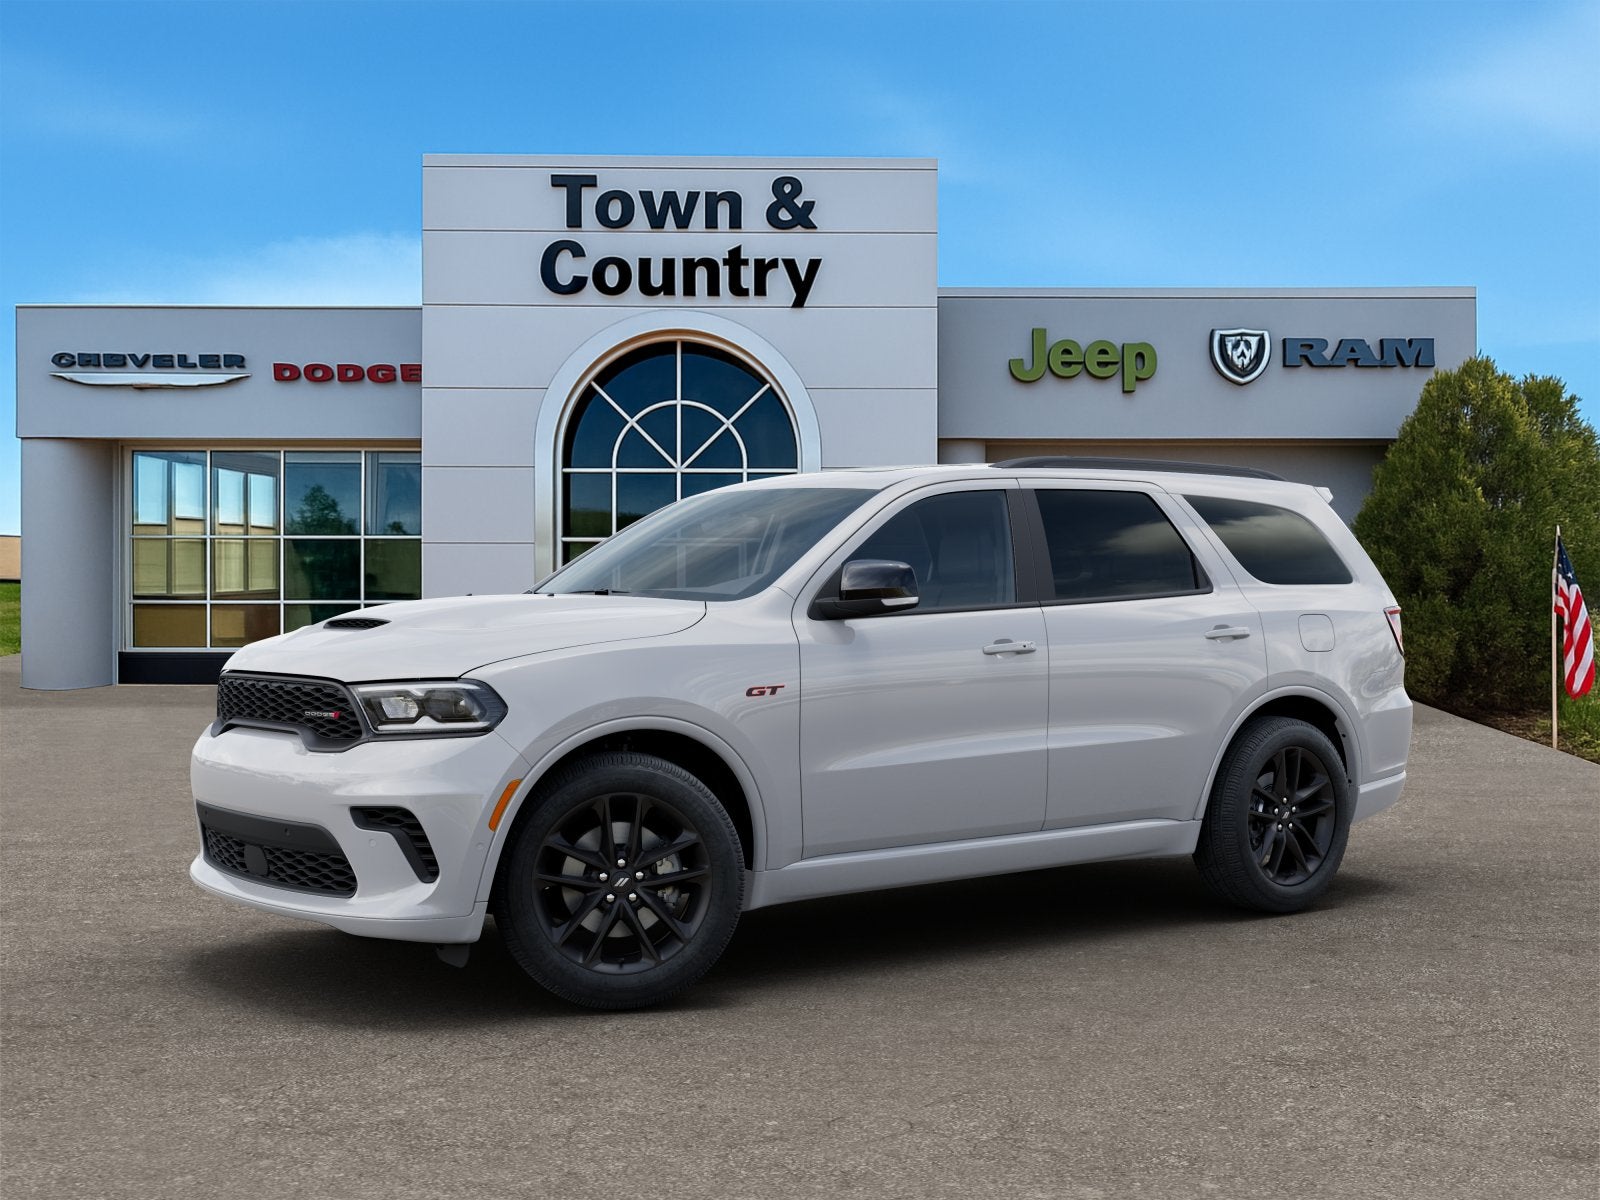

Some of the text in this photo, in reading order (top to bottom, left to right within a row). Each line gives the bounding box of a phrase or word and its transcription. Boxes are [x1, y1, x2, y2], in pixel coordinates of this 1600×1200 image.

[550, 174, 818, 229] Town &
[540, 239, 822, 308] Country
[272, 363, 422, 383] DODGE
[1009, 327, 1158, 393] Jeep
[1282, 337, 1436, 368] RAM
[746, 685, 785, 697] GT
